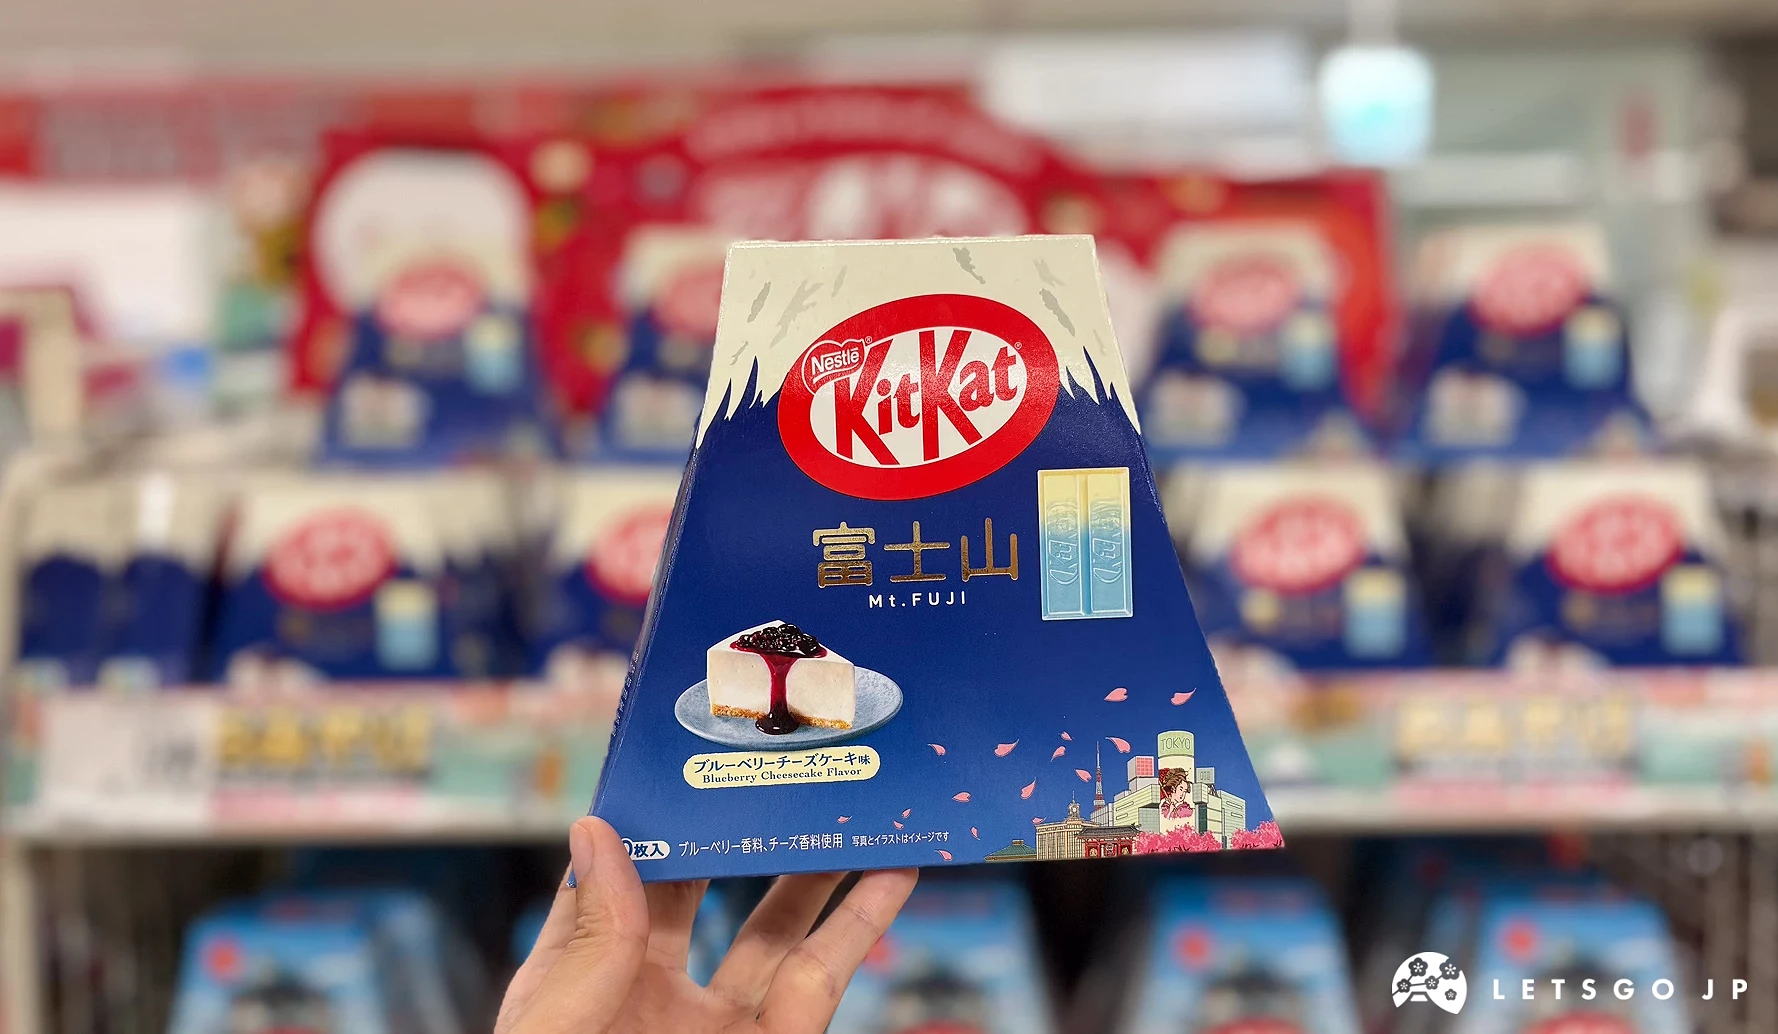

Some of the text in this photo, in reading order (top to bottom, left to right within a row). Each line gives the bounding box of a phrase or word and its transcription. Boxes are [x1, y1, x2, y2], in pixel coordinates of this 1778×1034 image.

[834, 329, 1017, 466] KitKat
[812, 517, 1019, 588] 富士山
[868, 590, 967, 609] Mt.FUJI
[1160, 737, 1191, 751] TOKYO
[693, 751, 872, 774] ブルーベリーチーズケーキ味
[702, 766, 862, 784] Blueberry Cheesecake Flavor
[678, 832, 844, 857] ブルーベリー香料、チーズ香料使用
[851, 831, 950, 847] 写真とイラストはイメージです
